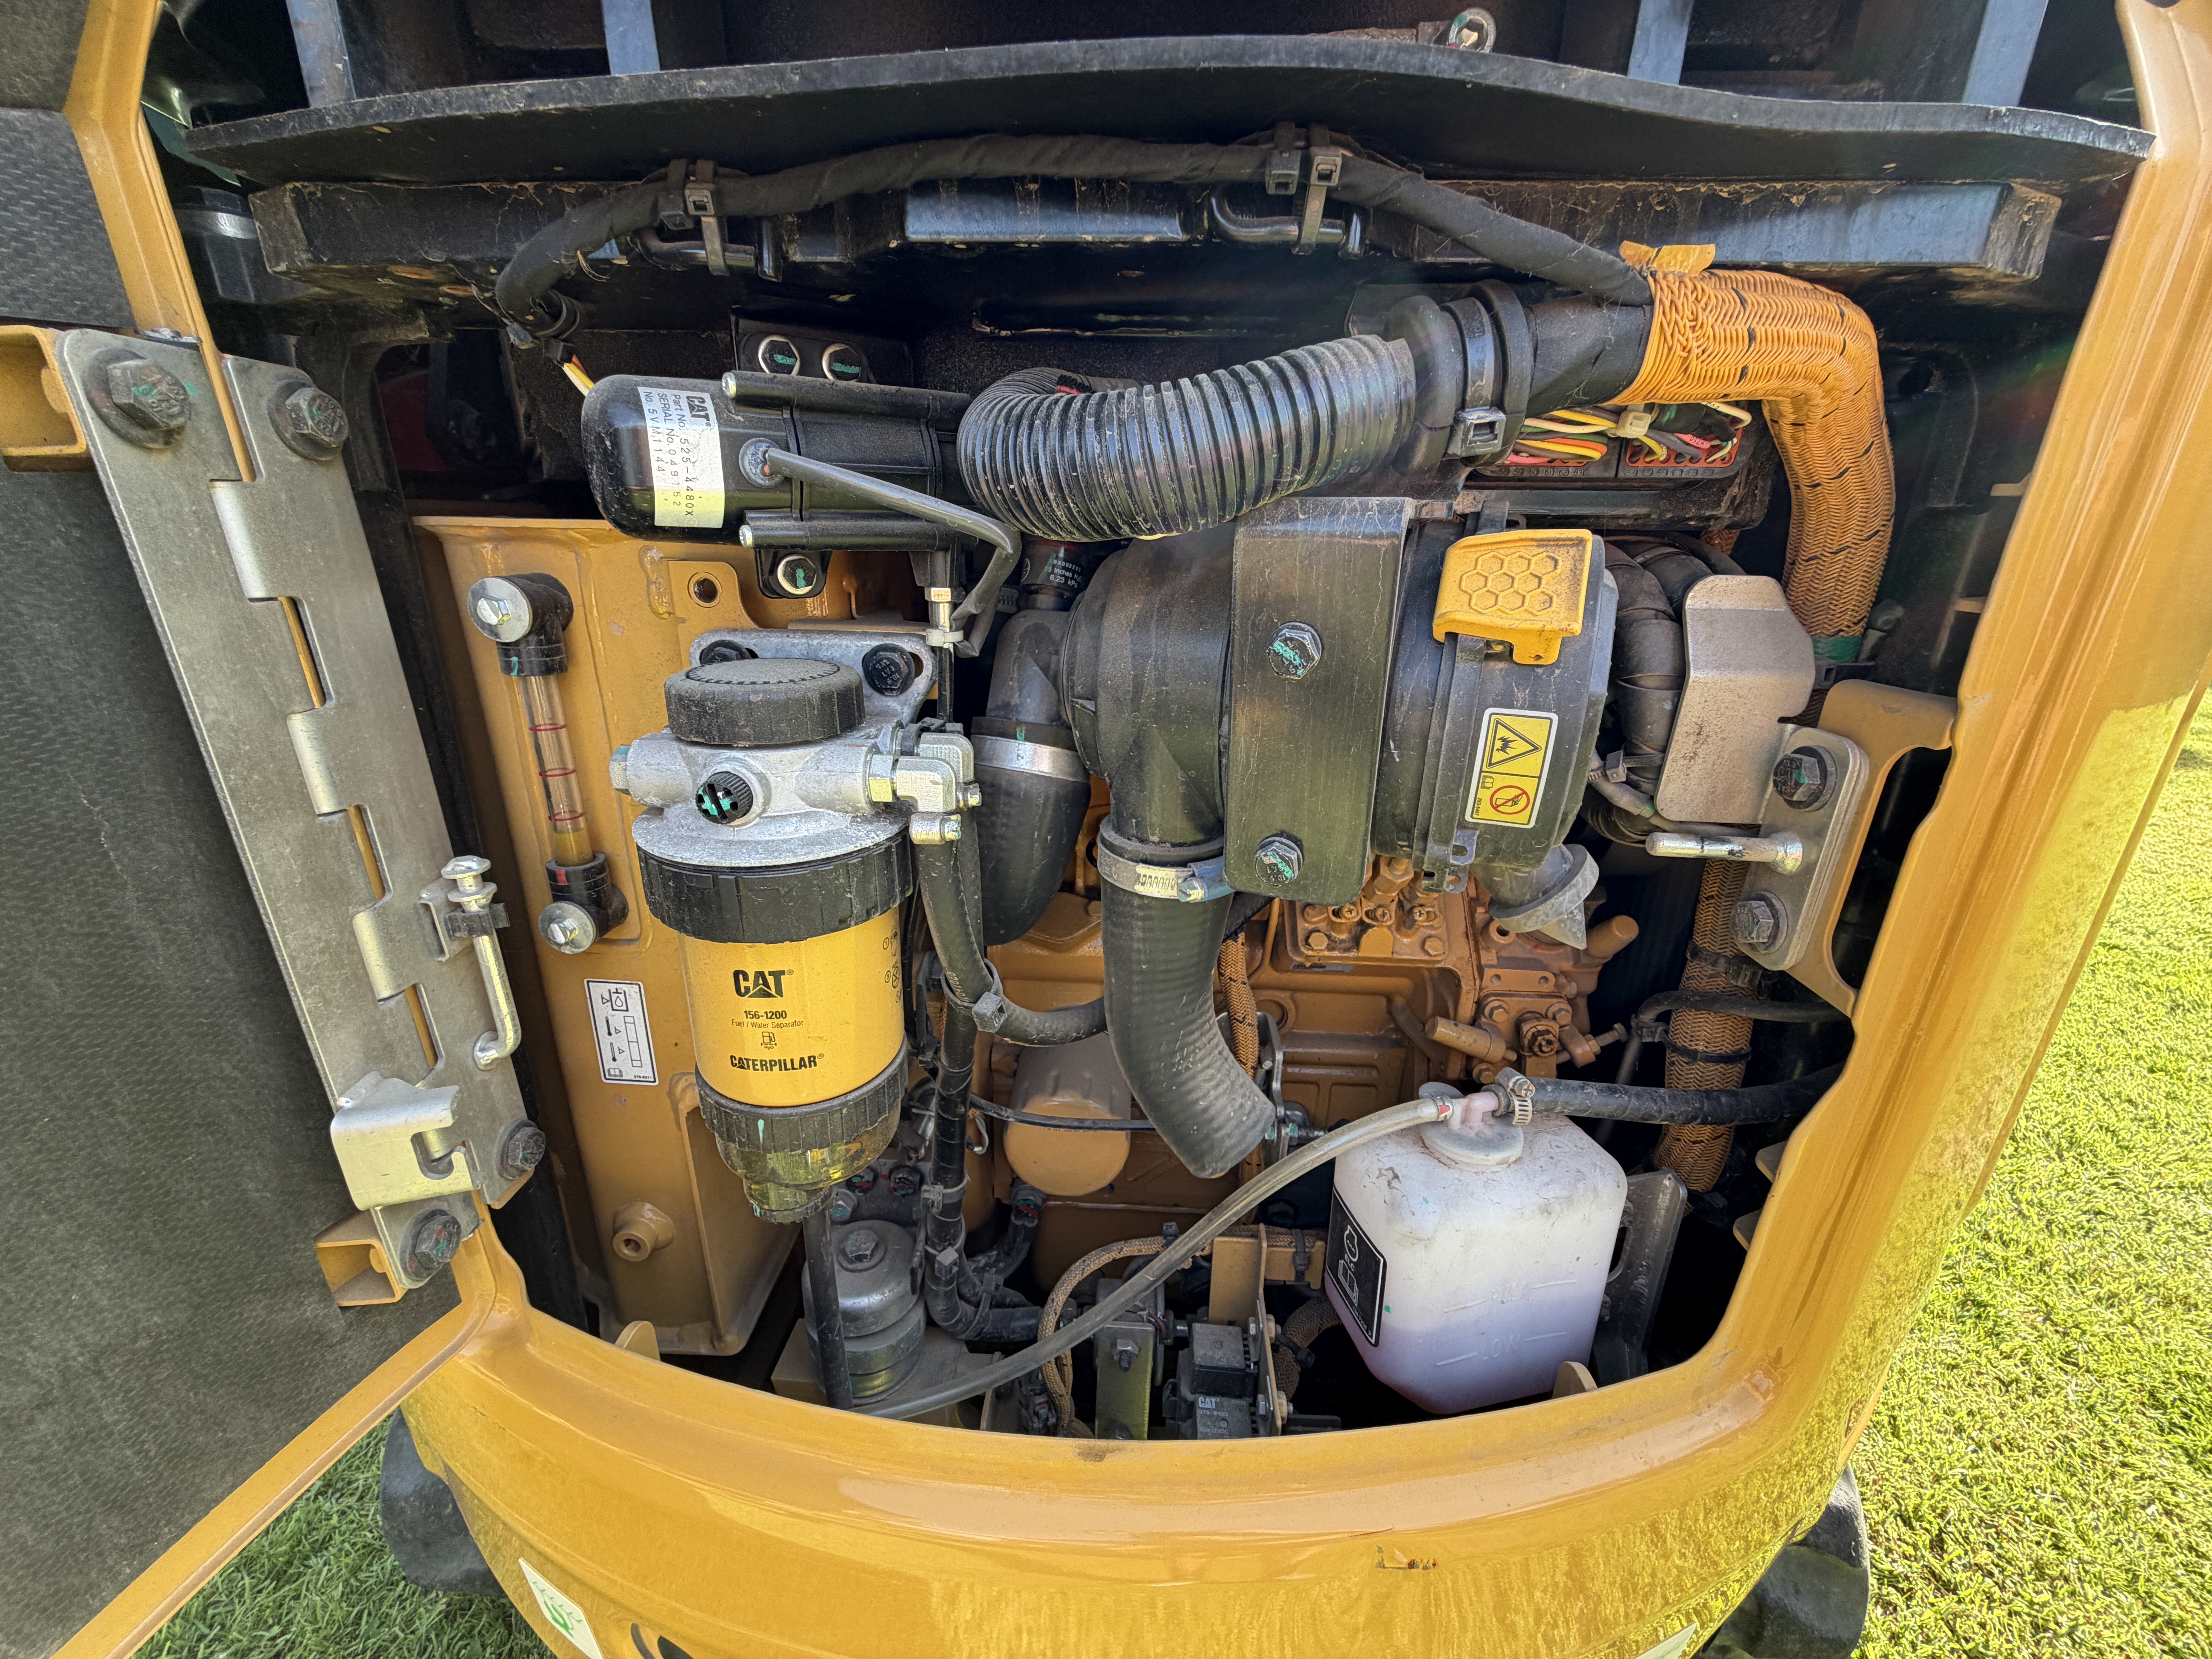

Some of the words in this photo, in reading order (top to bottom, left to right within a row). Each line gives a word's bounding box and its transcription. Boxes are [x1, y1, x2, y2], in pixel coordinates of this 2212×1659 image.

[643, 391, 654, 404] No.
[672, 393, 684, 412] Part
[657, 393, 673, 424] SERIAL
[665, 428, 675, 446] No.
[676, 414, 687, 430] No.
[1559, 467, 1568, 476] 62
[1573, 467, 1583, 476] 63
[1054, 567, 1073, 578] Inches
[1049, 574, 1065, 583] 6.23
[1068, 579, 1078, 588] kPa
[744, 1010, 788, 1020] 156-1200
[731, 1019, 745, 1027] Fuel
[771, 1020, 804, 1029] Separator
[1345, 1253, 1355, 1271] ELC
